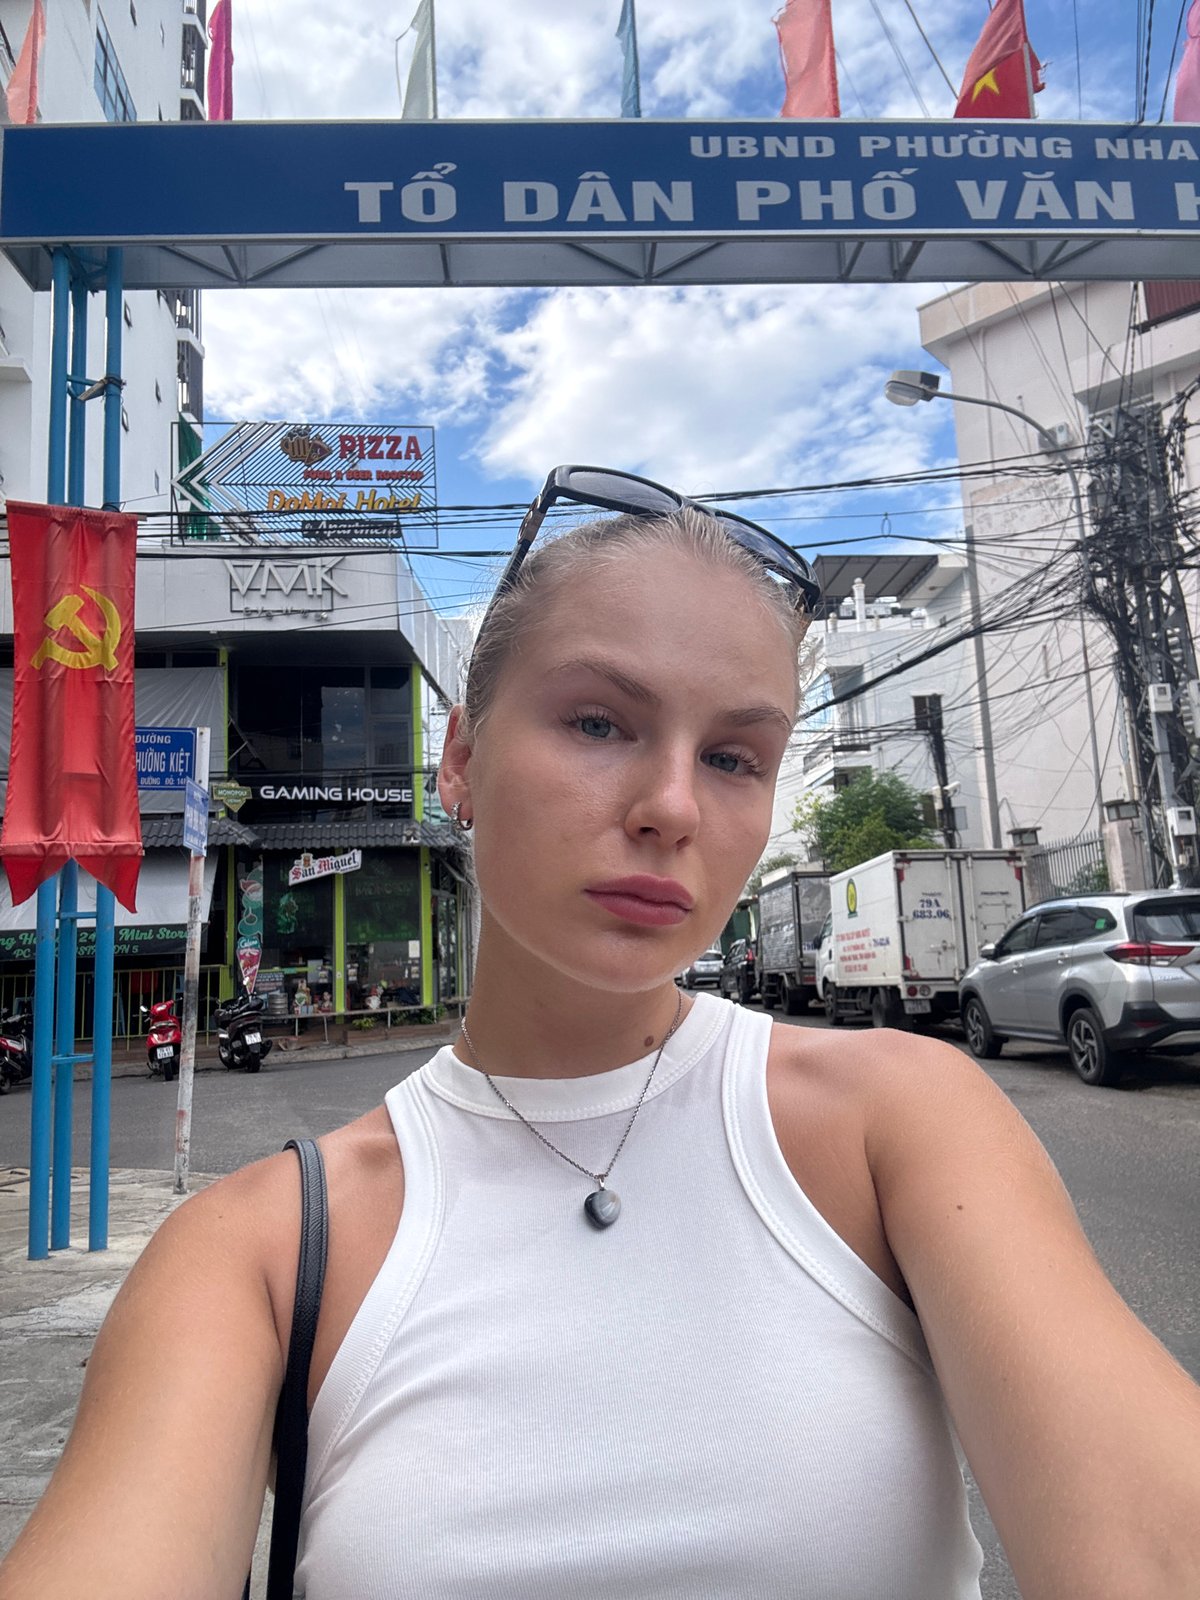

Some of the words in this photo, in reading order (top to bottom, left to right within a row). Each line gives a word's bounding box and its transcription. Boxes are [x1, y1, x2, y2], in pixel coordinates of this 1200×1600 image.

[690, 136, 835, 158] UBND
[860, 130, 1072, 159] PHƯỜNG
[1095, 138, 1199, 160] NHA
[344, 162, 457, 223] TỔ
[504, 171, 694, 222] DÂN
[736, 168, 918, 221] PHỐ
[956, 171, 1135, 221] VĂN
[338, 434, 422, 460] PIZZA
[356, 489, 422, 513] Hotel
[224, 556, 348, 597] VMK
[136, 747, 166, 772] HƯỜNG
[169, 747, 191, 777] KIỆT
[260, 785, 342, 801] GAMING
[347, 788, 413, 803] HOUSE
[291, 866, 315, 881] San
[317, 852, 357, 873] Miguel
[912, 909, 951, 920] 683.06
[919, 899, 941, 908] 79A
[119, 927, 154, 941] Mini
[13, 948, 31, 958] PC
